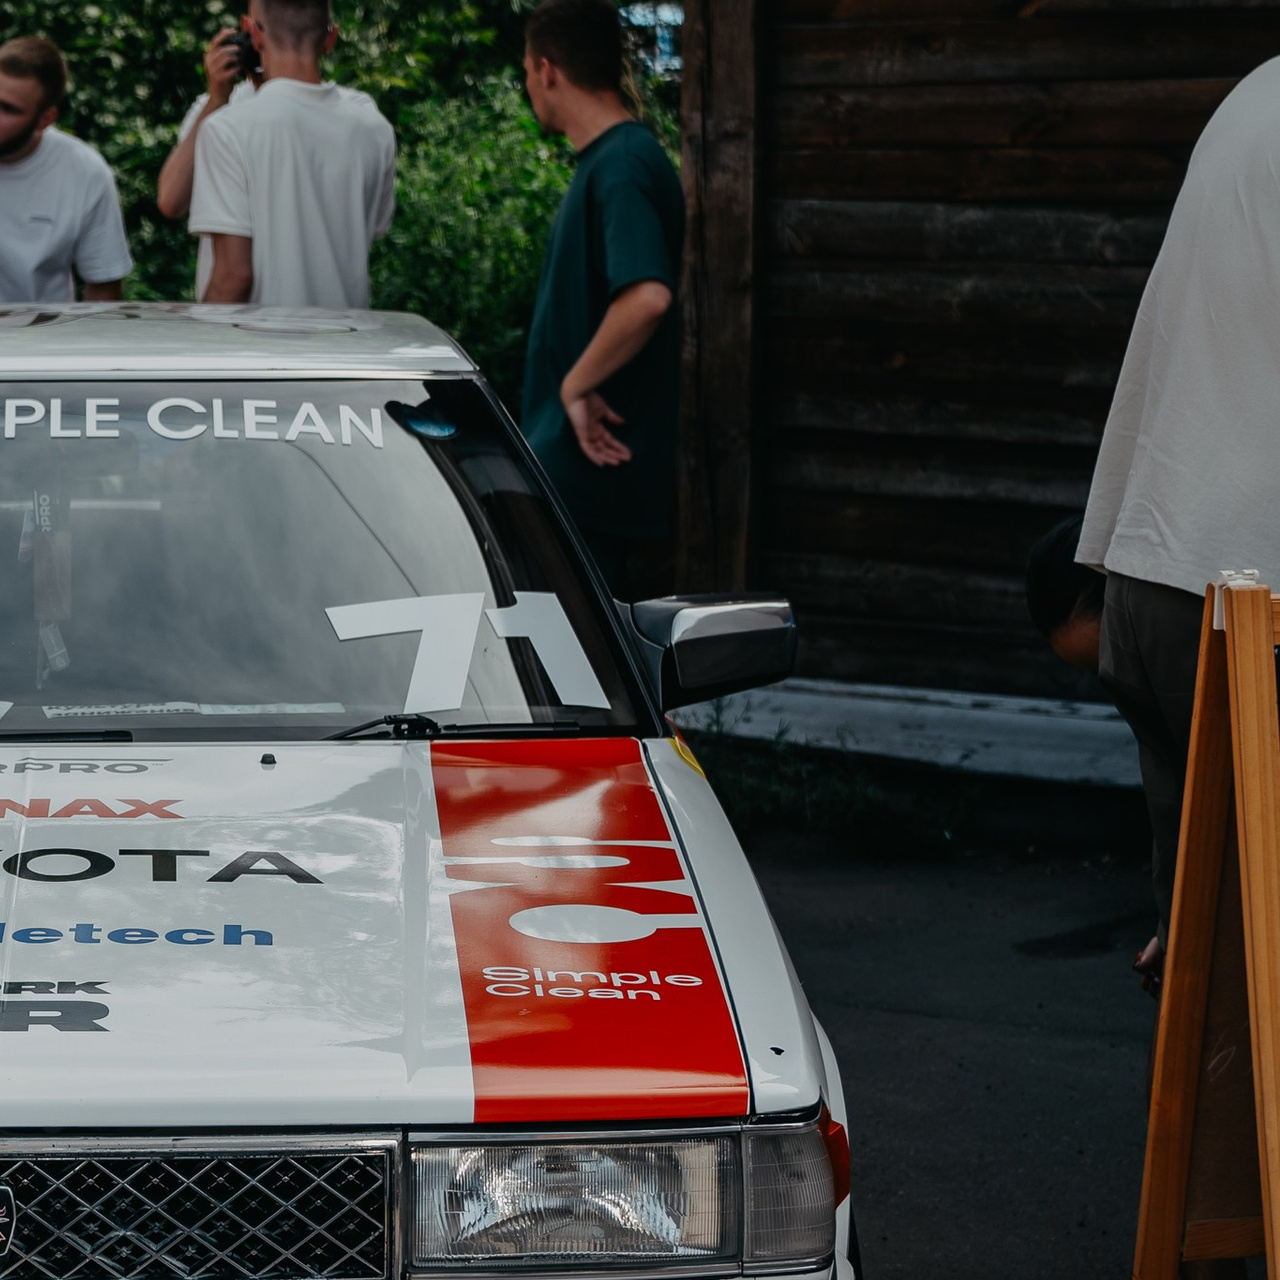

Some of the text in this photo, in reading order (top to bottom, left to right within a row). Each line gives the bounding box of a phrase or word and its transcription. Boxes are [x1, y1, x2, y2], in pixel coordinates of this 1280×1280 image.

[146, 396, 384, 449] CLEAN
[324, 591, 612, 715] 71
[482, 966, 703, 987] Simple
[484, 982, 661, 1001] Clean
